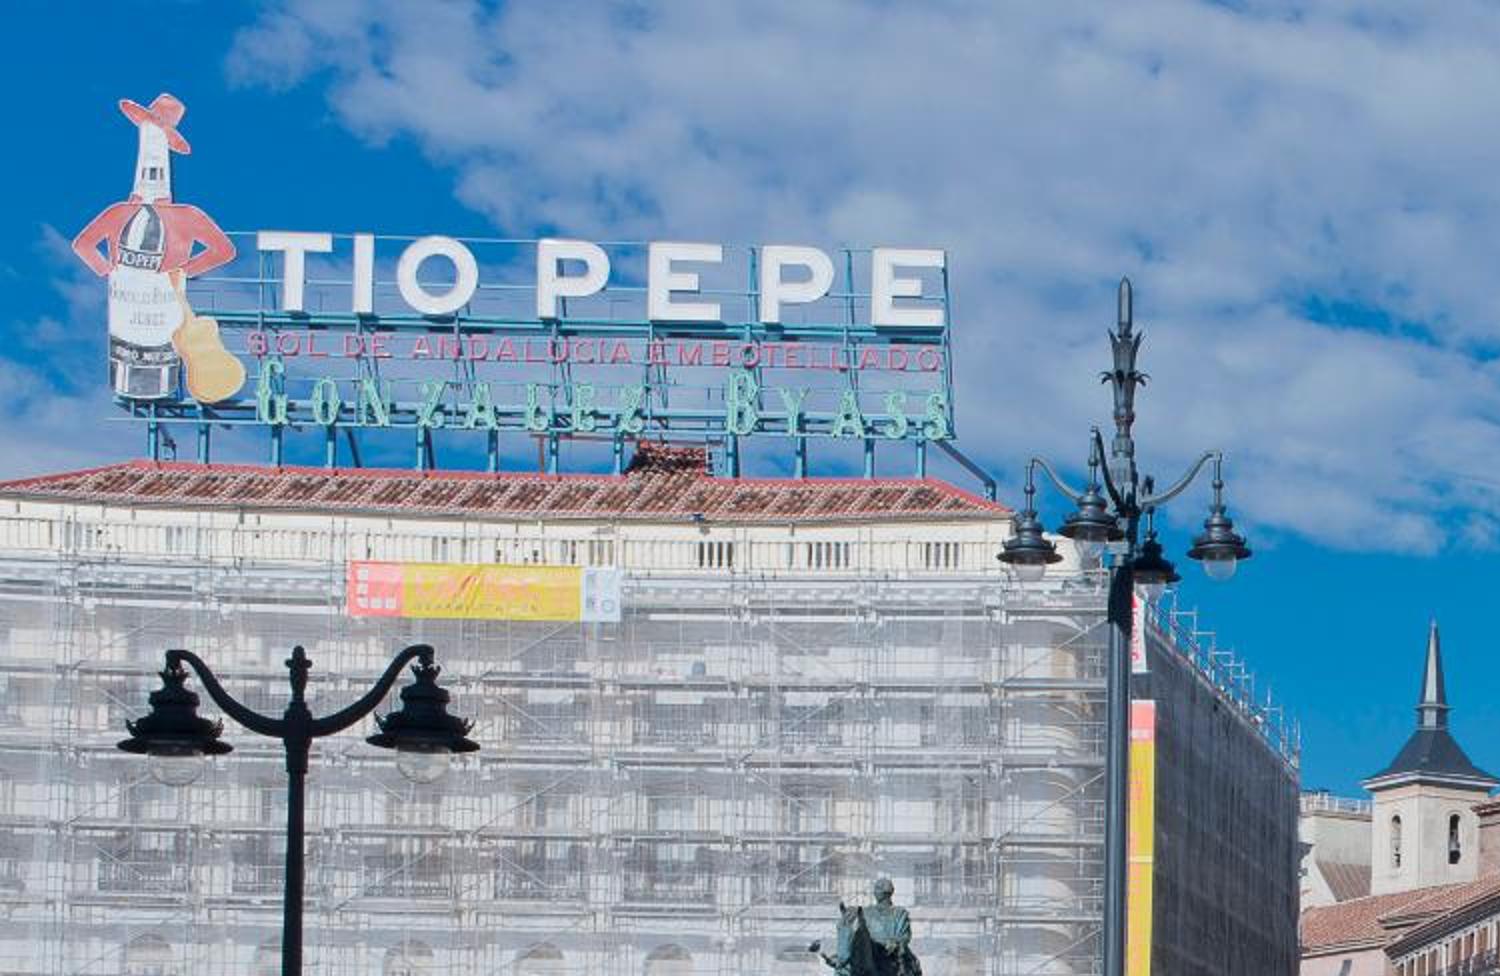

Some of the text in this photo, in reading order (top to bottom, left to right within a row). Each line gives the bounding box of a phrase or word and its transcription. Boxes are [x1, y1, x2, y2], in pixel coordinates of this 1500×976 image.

[257, 231, 945, 327] TIO PEPE
[247, 332, 328, 357] SOL
[345, 334, 392, 358] DE
[650, 341, 941, 372] EMBOTELLADO
[256, 360, 949, 440] GONZALEZ BYASS
